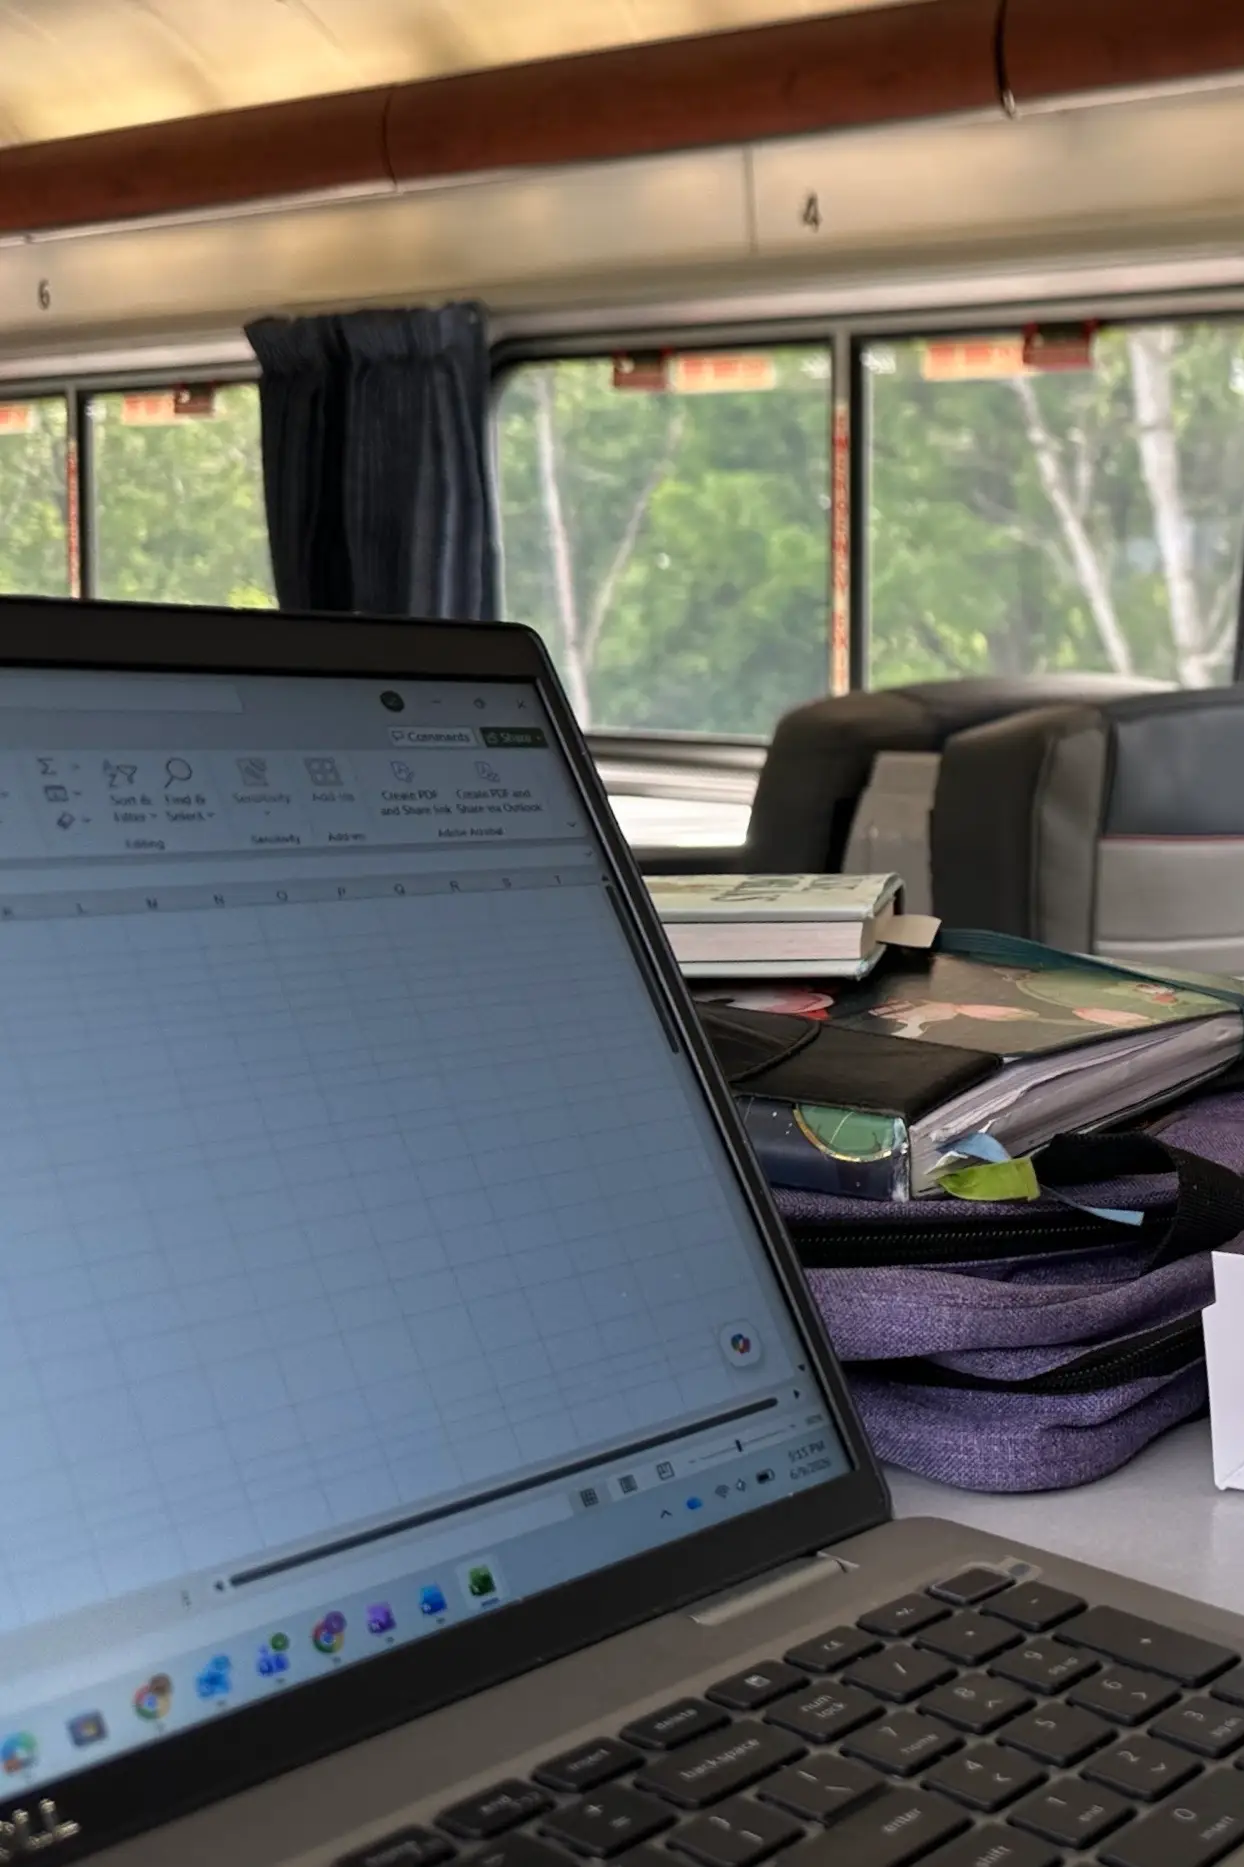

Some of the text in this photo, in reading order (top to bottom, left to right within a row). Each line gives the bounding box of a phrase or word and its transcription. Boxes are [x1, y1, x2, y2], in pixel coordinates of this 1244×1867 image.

[801, 191, 822, 233] 4
[38, 278, 51, 311] 6
[407, 731, 471, 744] Comments
[500, 732, 532, 743] Share
[402, 805, 432, 816] Share
[1101, 1678, 1122, 1691] 6
[953, 1686, 977, 1701] 8
[800, 1692, 834, 1714] num
[1183, 1710, 1205, 1724] 3
[1035, 1718, 1057, 1732] 5
[679, 1736, 761, 1782] backspace
[1118, 1750, 1141, 1764] 2
[966, 1760, 986, 1772] 4
[881, 1806, 923, 1836] enter
